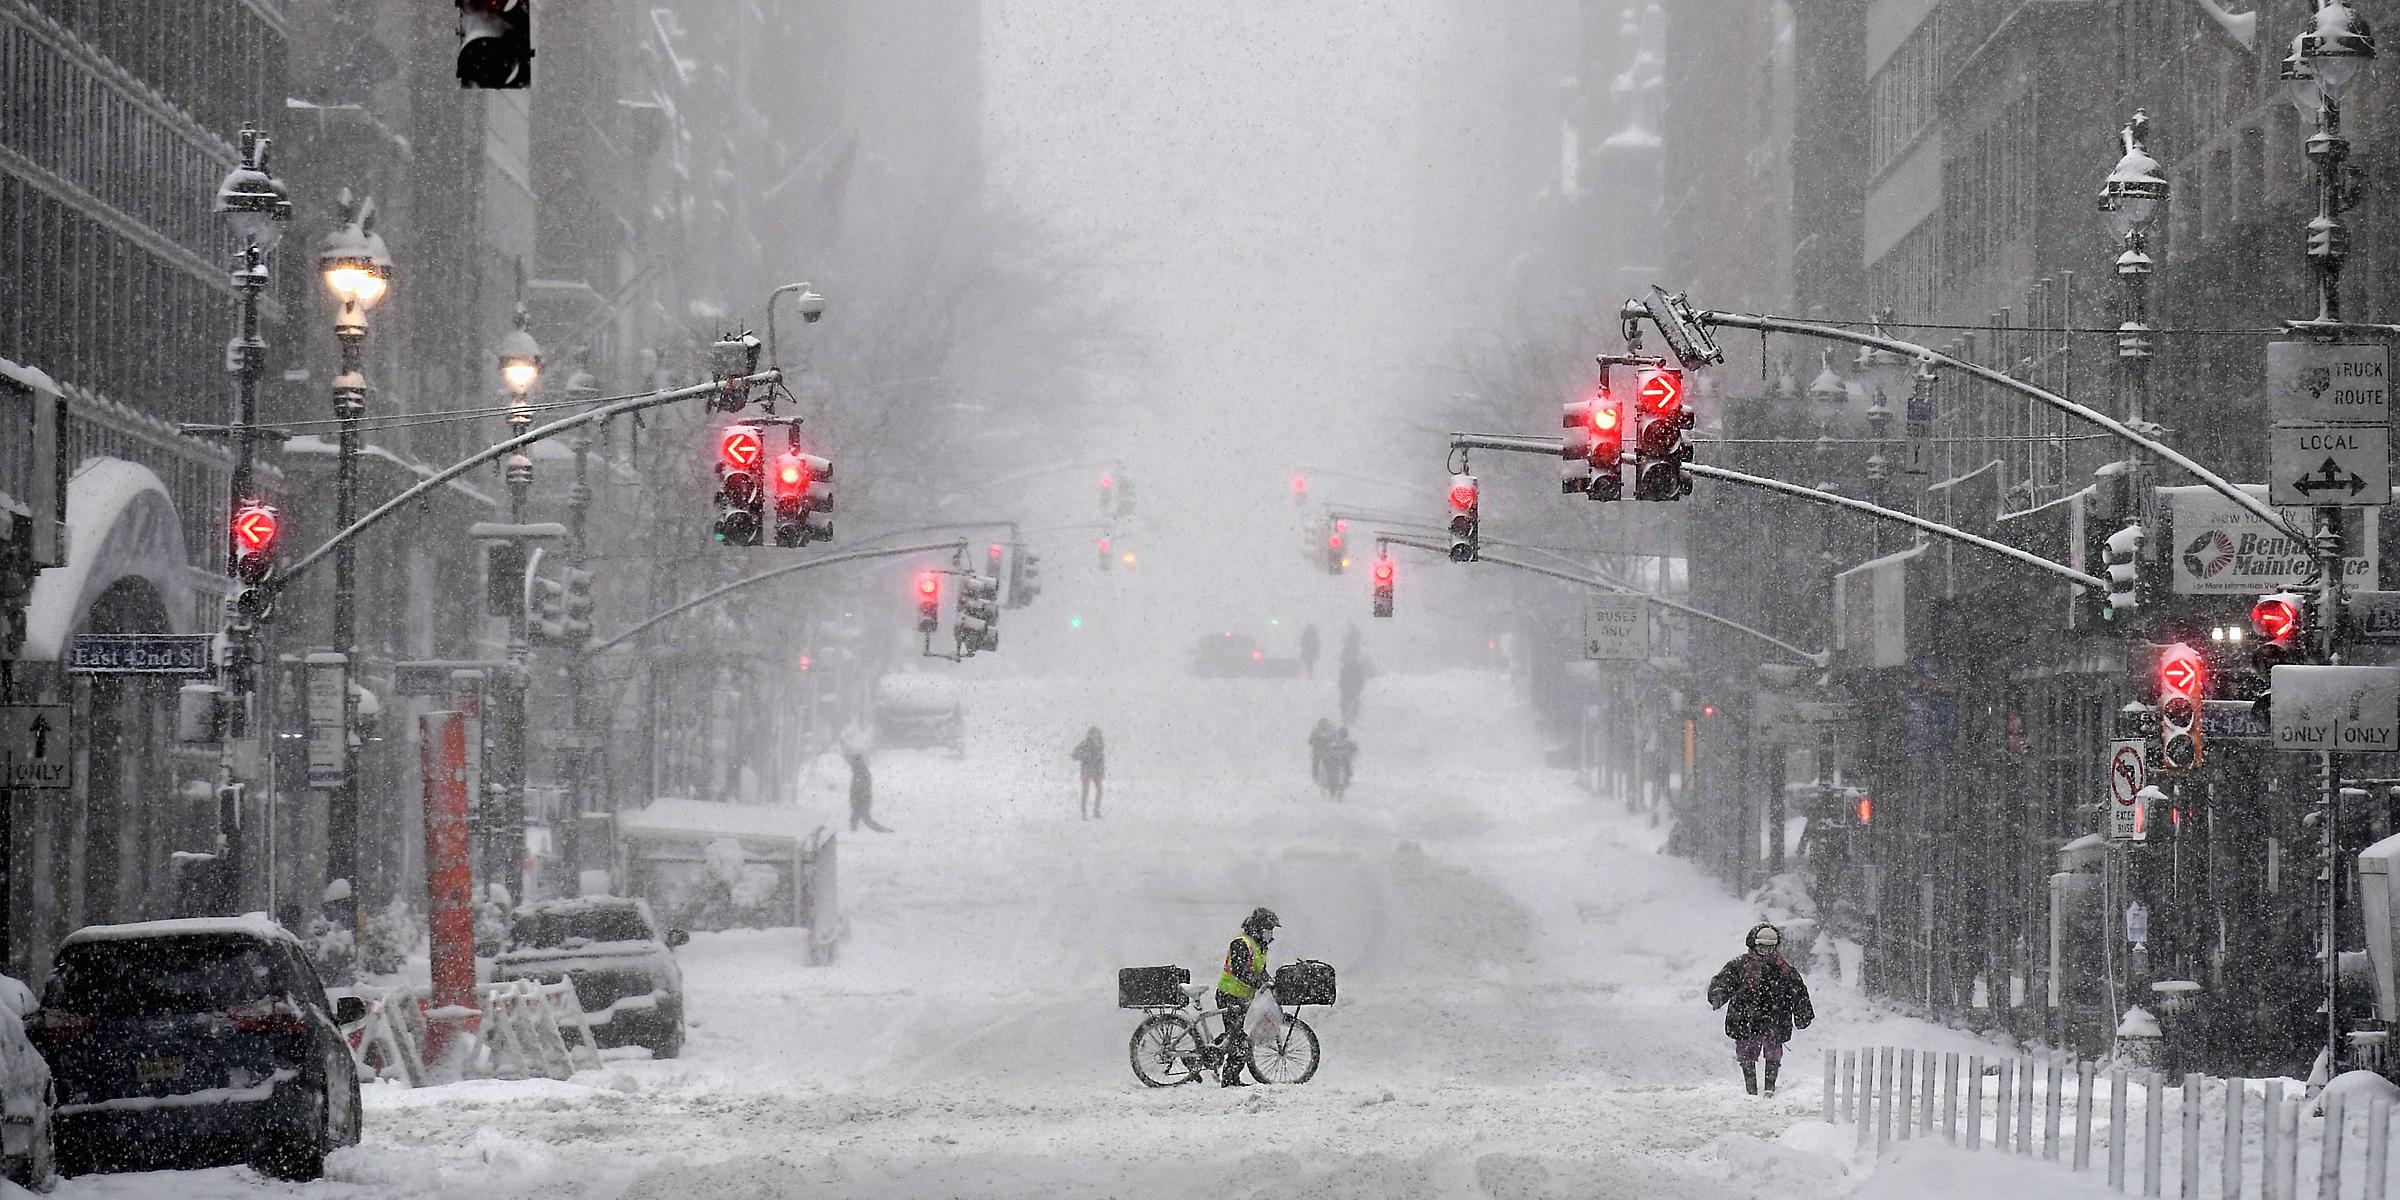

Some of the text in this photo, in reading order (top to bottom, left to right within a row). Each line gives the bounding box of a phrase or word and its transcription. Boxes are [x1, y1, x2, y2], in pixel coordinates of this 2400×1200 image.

[2334, 362, 2383, 377] TRUCK
[2334, 389, 2383, 404] ROUTE
[2300, 435, 2358, 450] LOCAL
[1597, 611, 1637, 622] BUSES
[1601, 626, 1632, 637] ONLY
[75, 648, 119, 665] East
[124, 648, 172, 665] 42nd
[2282, 726, 2390, 743] ONLY ONLY
[16, 764, 64, 780] ONLY
